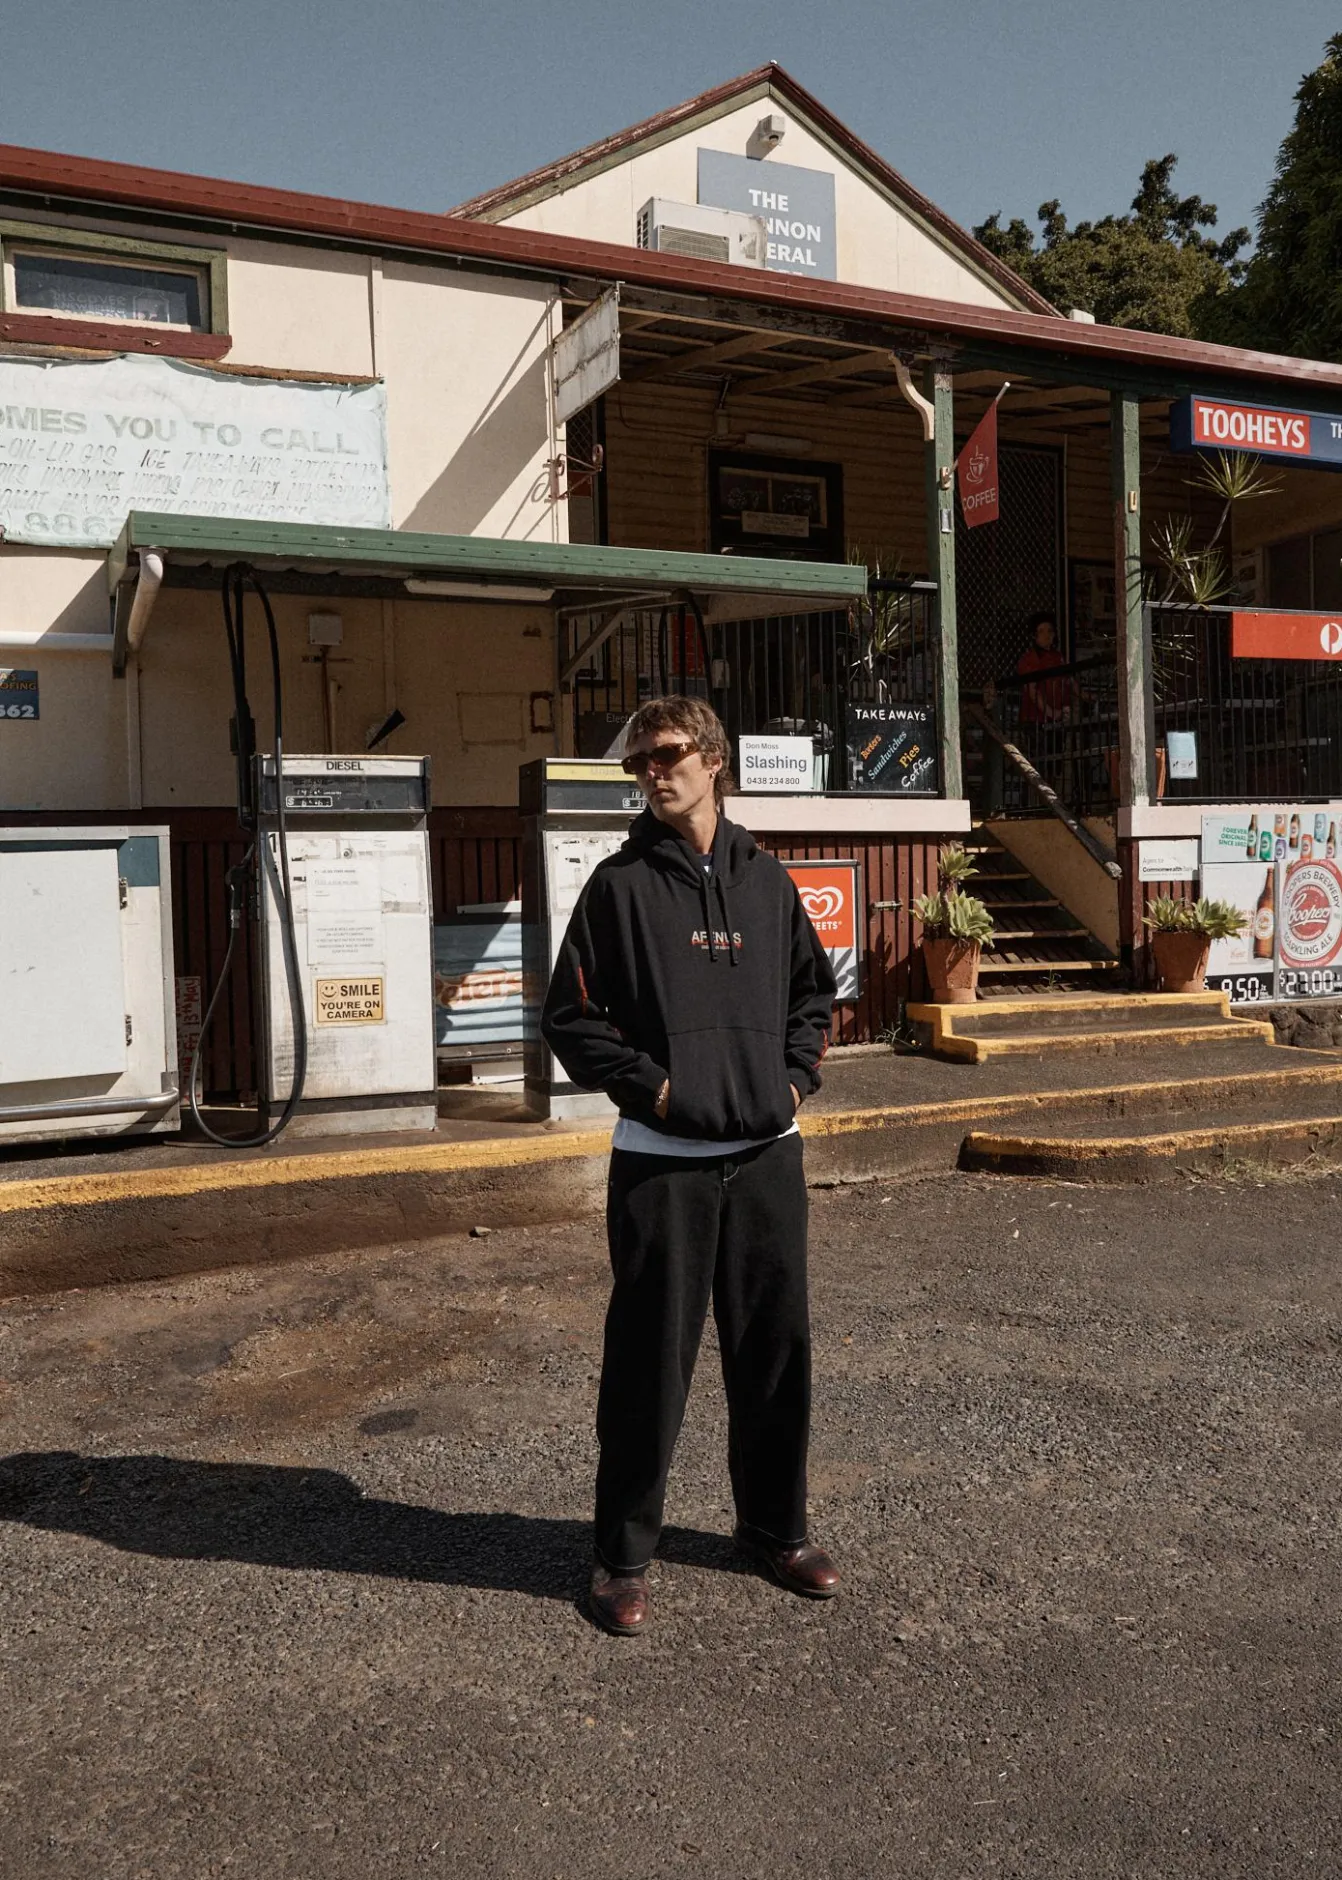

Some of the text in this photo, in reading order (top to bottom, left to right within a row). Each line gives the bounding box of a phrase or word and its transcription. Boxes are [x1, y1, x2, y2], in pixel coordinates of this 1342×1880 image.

[748, 188, 789, 212] THE
[767, 242, 816, 266] ERAL
[0, 404, 360, 455] MES YOU TO CALL
[1198, 406, 1306, 449] TOOHEYS
[140, 448, 171, 468] ICE
[962, 487, 996, 511] COFFEE
[855, 708, 886, 721] TAKE
[326, 761, 364, 771] DIESEL
[745, 755, 807, 773] Slashing
[867, 730, 907, 780] Sandwiches
[898, 744, 921, 769] Pies
[746, 777, 800, 785] 0438 234 800
[900, 756, 935, 788] Coffee
[1313, 871, 1341, 909] BREWERY
[1320, 933, 1333, 950] ALE
[340, 983, 380, 997] SMILE
[320, 1000, 380, 1010] YOU'RE ON
[326, 1010, 373, 1019] CAMERA
